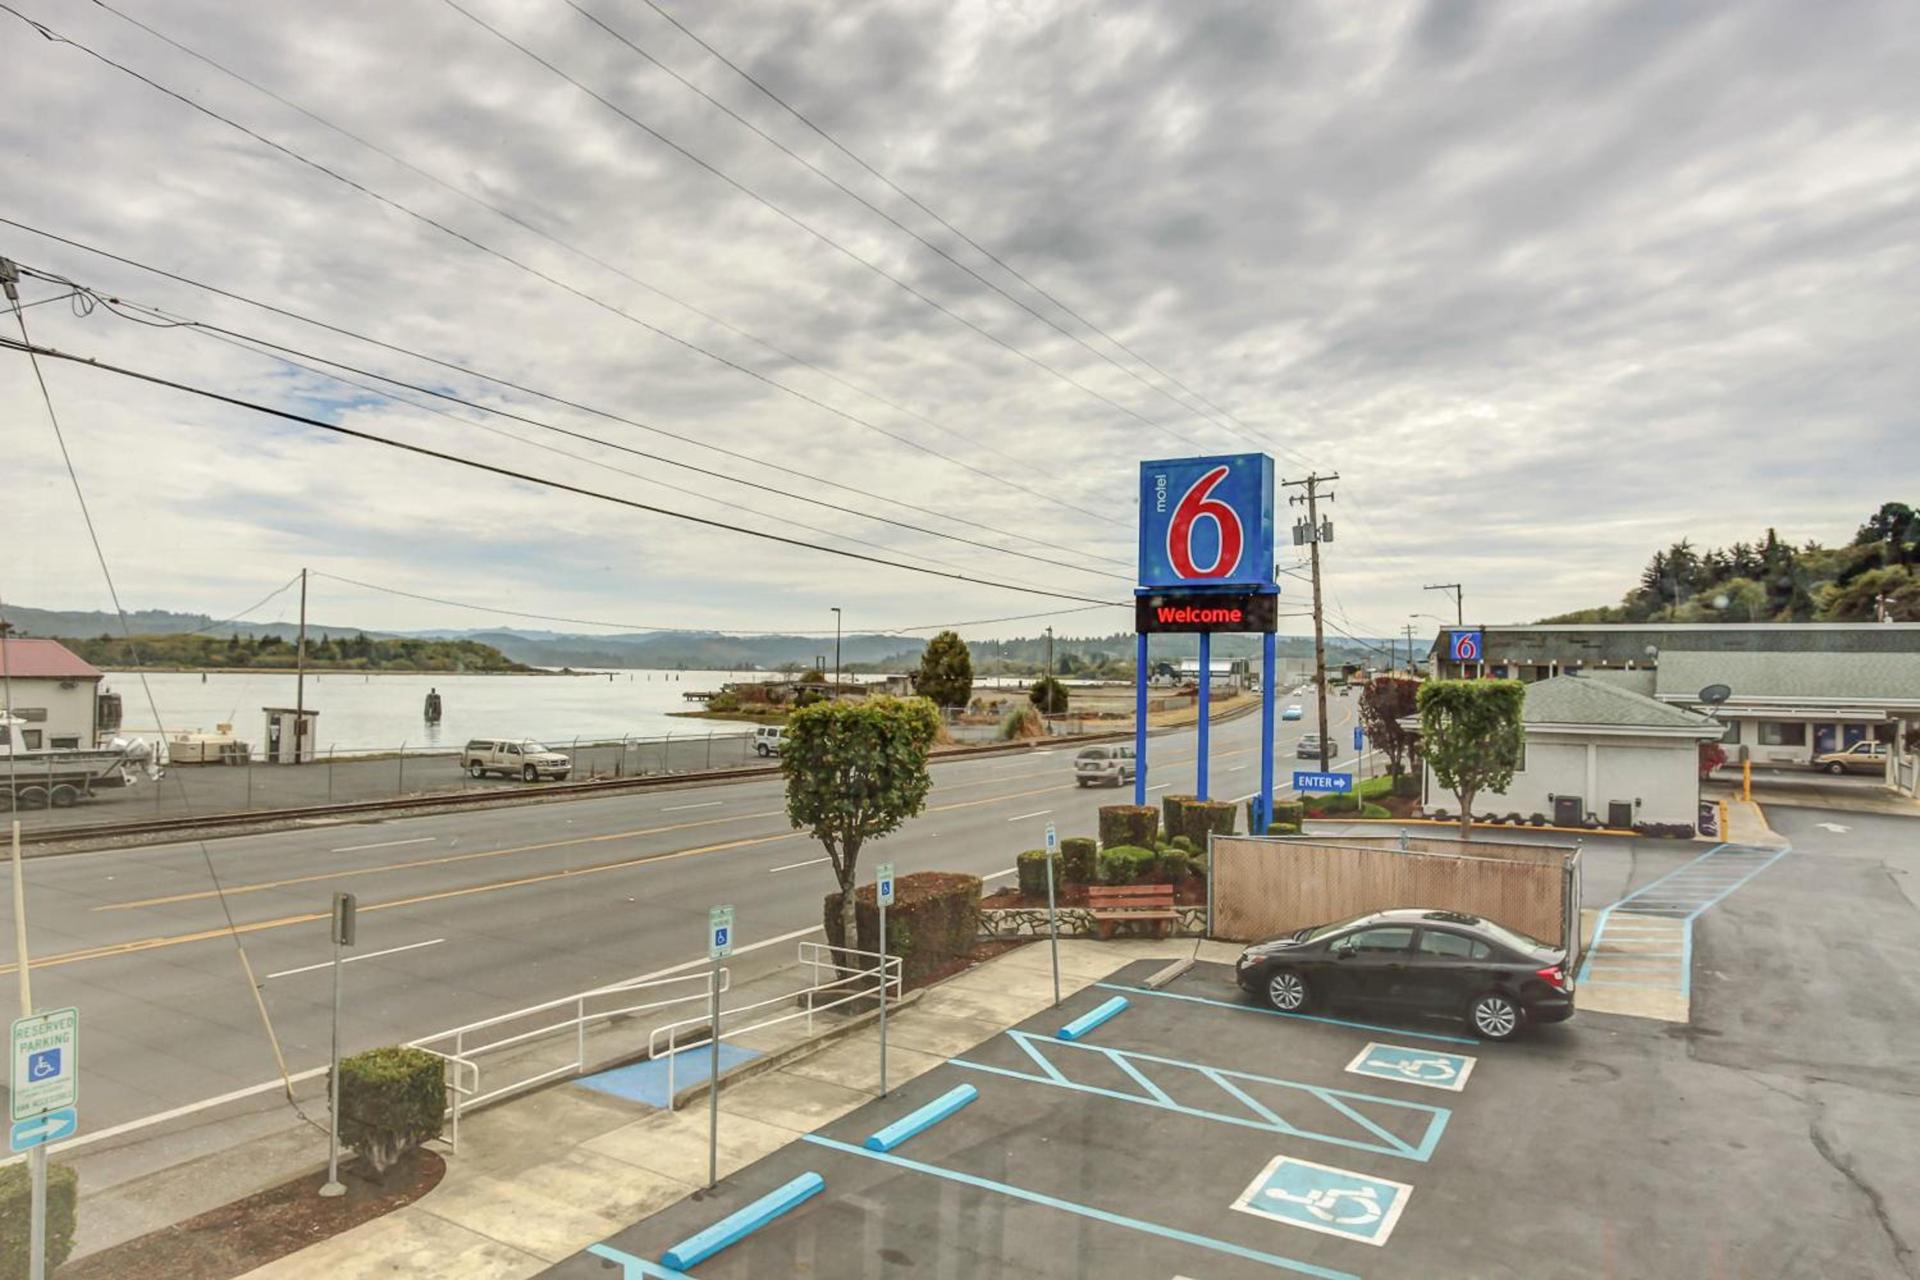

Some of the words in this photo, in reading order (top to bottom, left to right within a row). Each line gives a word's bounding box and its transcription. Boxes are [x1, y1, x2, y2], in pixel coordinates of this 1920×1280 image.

[1155, 474, 1166, 512] motel
[1166, 465, 1244, 579] 6
[1157, 606, 1242, 623] Welcome
[1456, 633, 1476, 660] 6
[1299, 776, 1332, 788] ENTER
[16, 1017, 73, 1039] RESERVED
[20, 1032, 70, 1053] PARKING
